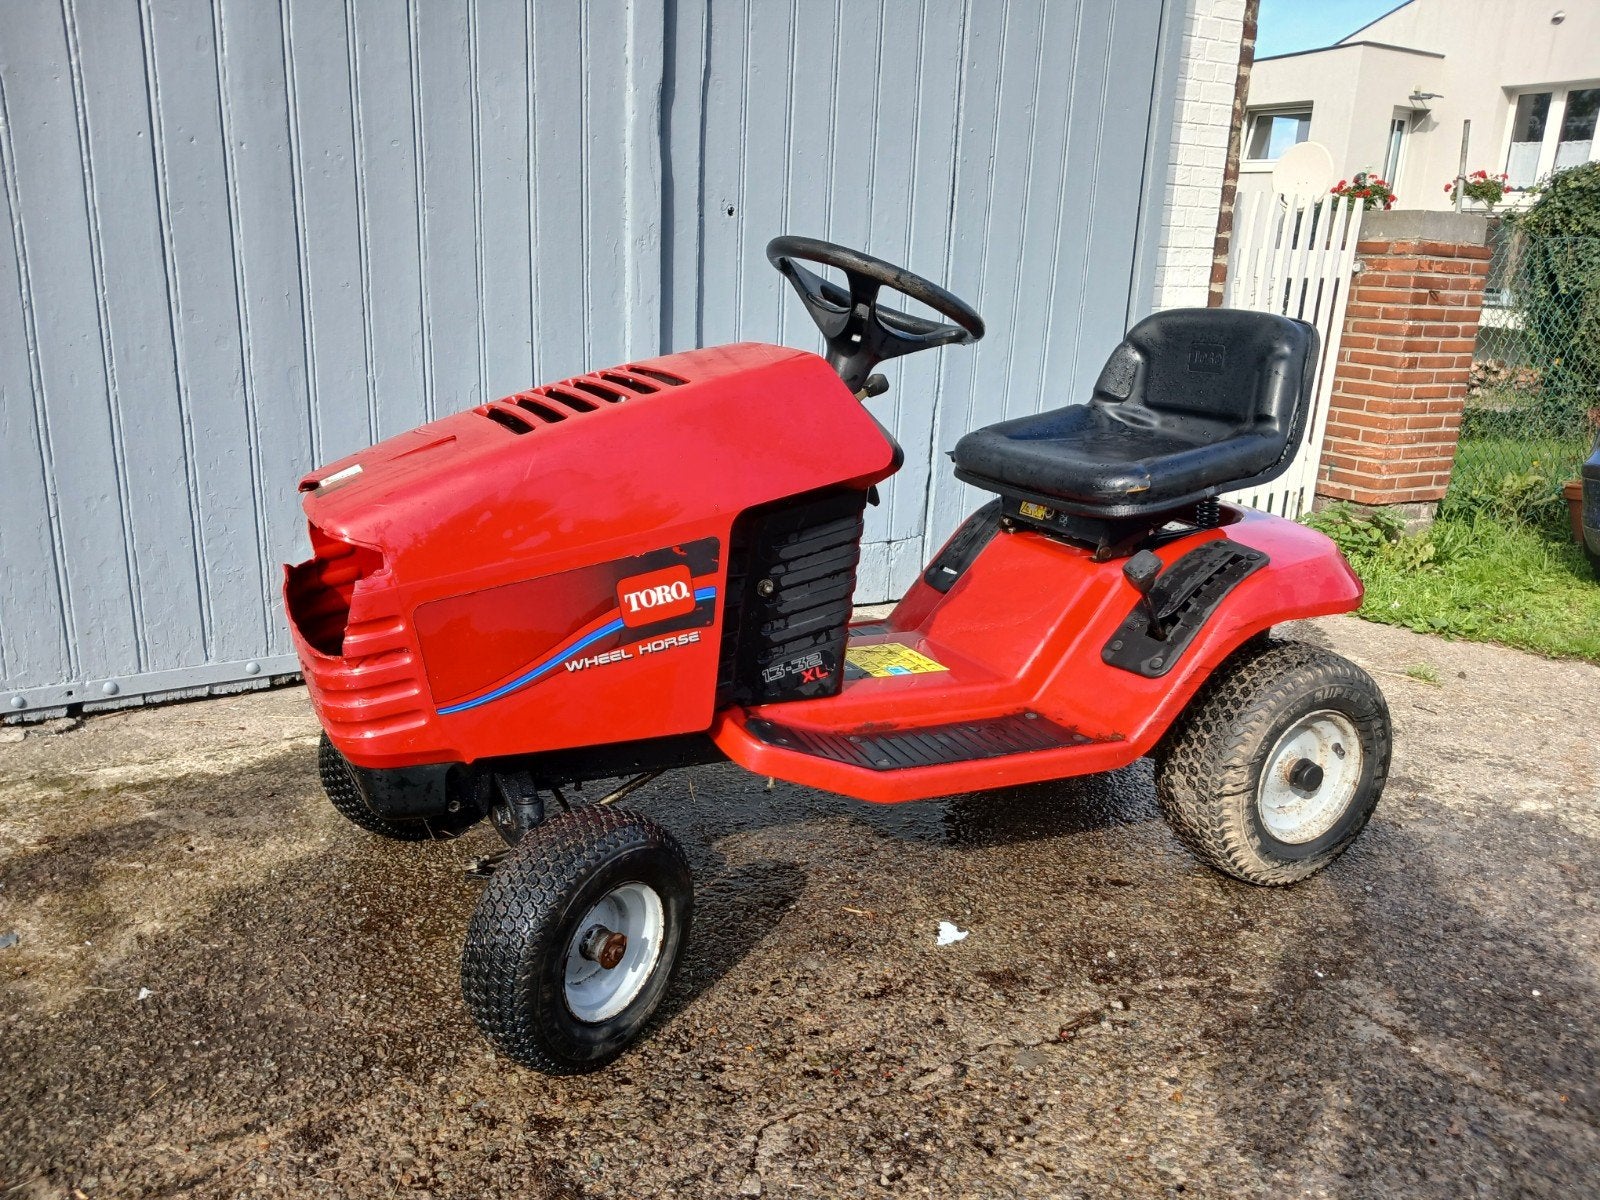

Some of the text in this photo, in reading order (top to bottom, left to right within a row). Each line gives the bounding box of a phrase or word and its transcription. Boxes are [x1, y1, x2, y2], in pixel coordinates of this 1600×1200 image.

[624, 580, 690, 612] TORO
[564, 630, 701, 673] WHEEL HORSE
[800, 663, 829, 684] XL
